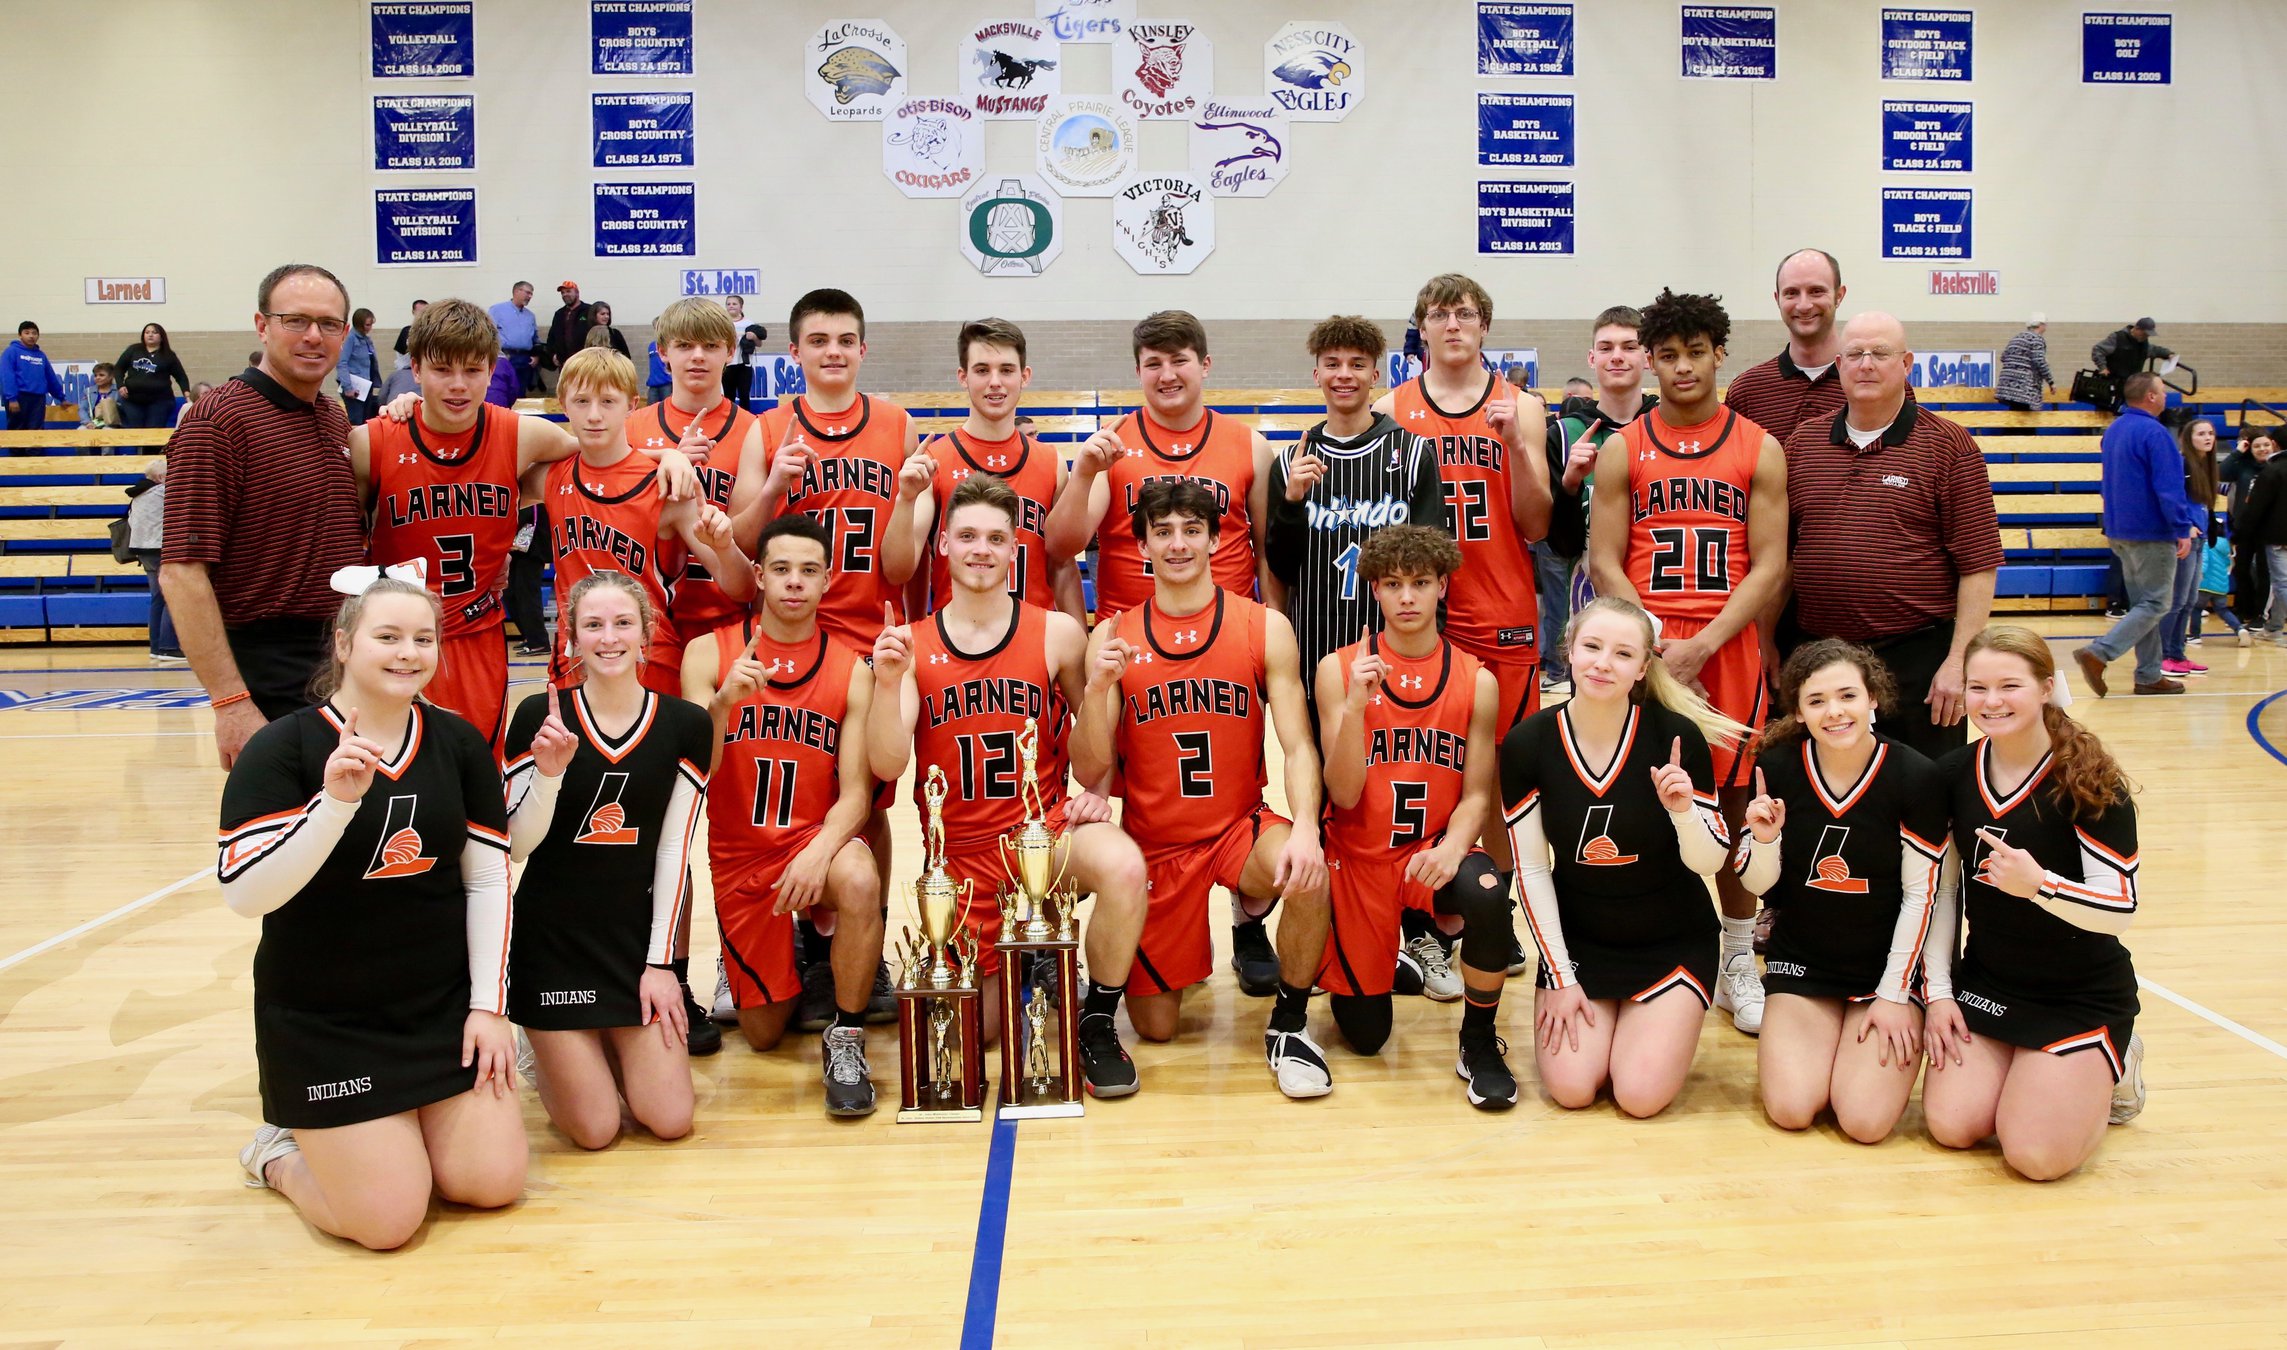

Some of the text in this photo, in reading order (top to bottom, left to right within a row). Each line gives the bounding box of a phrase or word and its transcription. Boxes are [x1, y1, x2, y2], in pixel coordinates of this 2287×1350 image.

[373, 5, 471, 14] STATE CHAMPIONS
[594, 3, 690, 12] STATE CHAMPIONS
[1480, 6, 1571, 15] STATE CHAMPIONS
[1684, 10, 1773, 19] STATE CHAMPIONS
[1884, 12, 1971, 22] STATE CHAMPIONS
[1041, 6, 1121, 39] Tigers
[2085, 16, 2114, 24] STATE
[628, 28, 656, 36] BOYS
[974, 22, 1042, 42] MACKSVILLE
[1128, 24, 1194, 42] KINSLEY
[1513, 29, 1539, 38] BOYS
[389, 35, 457, 45] VOLLEYBALL
[599, 38, 685, 48] CROSS COUNTRY
[1272, 31, 1356, 56] NESS CITY
[1493, 39, 1559, 49] BASKETBALL
[1683, 37, 1774, 47] BOYS BASKETBALL
[1933, 41, 1966, 50] TRACK
[1919, 51, 1944, 60] FIELD
[385, 65, 419, 74] CLASS
[421, 65, 434, 74] 1A
[605, 62, 680, 71] CLASS 2A 1973
[1490, 63, 1522, 71] CLASS
[1524, 63, 1537, 71] 2A
[1693, 66, 1764, 75] CLASS 2A 2015
[1893, 68, 1923, 76] CLASS
[1925, 69, 1938, 77] 2A
[2093, 72, 2123, 80] CLASS
[2125, 72, 2136, 80] 1A
[376, 99, 471, 107] STATE CHAMPIONS
[595, 95, 690, 105] STATE CHAMPIONS
[976, 94, 1048, 114] MUSTANGS
[1122, 89, 1196, 118] Coyotes
[1480, 97, 1572, 106] STATE CHAMPIONS
[830, 106, 882, 118] Leopards
[1204, 102, 1278, 120] Ellinwood
[1884, 103, 1971, 113] STATE CHAMPIONS
[391, 122, 458, 132] VOLLEYBALL
[629, 120, 657, 129] BOYS
[1040, 101, 1133, 153] CENTRAL PRAIRIE LEAGUE
[1513, 120, 1539, 129] BOYS
[399, 133, 450, 143] DIVISION I
[600, 131, 685, 140] CROSS COUNTRY
[1494, 131, 1559, 140] BASKETBALL
[1929, 132, 1962, 141] TRACK
[1919, 142, 1944, 151] FIELD
[388, 156, 462, 166] CLASS 1A 2010
[605, 154, 682, 164] CLASS 2A 1975
[1489, 154, 1563, 163] CLASS 2A 2007
[1893, 159, 1923, 168] CLASS
[1926, 160, 1939, 168] 2A
[896, 168, 971, 190] COUGARS
[1210, 166, 1274, 192] Eagles
[596, 186, 692, 195] STATE CHAMPIONS
[1122, 178, 1201, 202] VICTORIA
[1480, 185, 1572, 194] STATE CHAMPIONS
[378, 192, 472, 202] STATE CHAMPIONS
[1884, 191, 1970, 200] STATE CHAMPIONS
[630, 210, 658, 219] BOYS
[1479, 208, 1573, 217] BOYS BASKETBALL
[392, 216, 460, 225] VOLLEYBALL
[602, 221, 687, 230] CROSS COUNTRY
[1501, 219, 1551, 227] DIVISION I
[400, 227, 452, 236] DIVISION I
[1893, 224, 1962, 233] TRACK FIELD
[607, 244, 683, 254] CLASS 2A 2016
[1491, 242, 1561, 251] CLASS 1A 2013
[1893, 247, 1923, 255] CLASS
[1925, 247, 1938, 255] 2A
[392, 251, 462, 260] CLASS 1A 2011
[686, 271, 755, 294] St. John
[1932, 271, 1996, 294] Macksville
[98, 279, 151, 301] Larned
[1427, 435, 1502, 473] ARNED
[387, 482, 511, 528] LARNED
[1633, 478, 1748, 526] LARNED
[1649, 527, 1730, 593] 20
[434, 534, 476, 597] 3
[925, 677, 1043, 728] LARNED
[1130, 677, 1250, 725] LARNED
[1365, 727, 1466, 773] ARNED
[954, 731, 1018, 800] 12
[1172, 730, 1214, 798] 2
[752, 757, 797, 828] 11
[1389, 780, 1428, 848] 5
[1767, 961, 1806, 977] INDIANS
[540, 990, 596, 1006] INDIANS
[1957, 990, 2007, 1017] INDIANS
[307, 1076, 372, 1102] INDIANS
